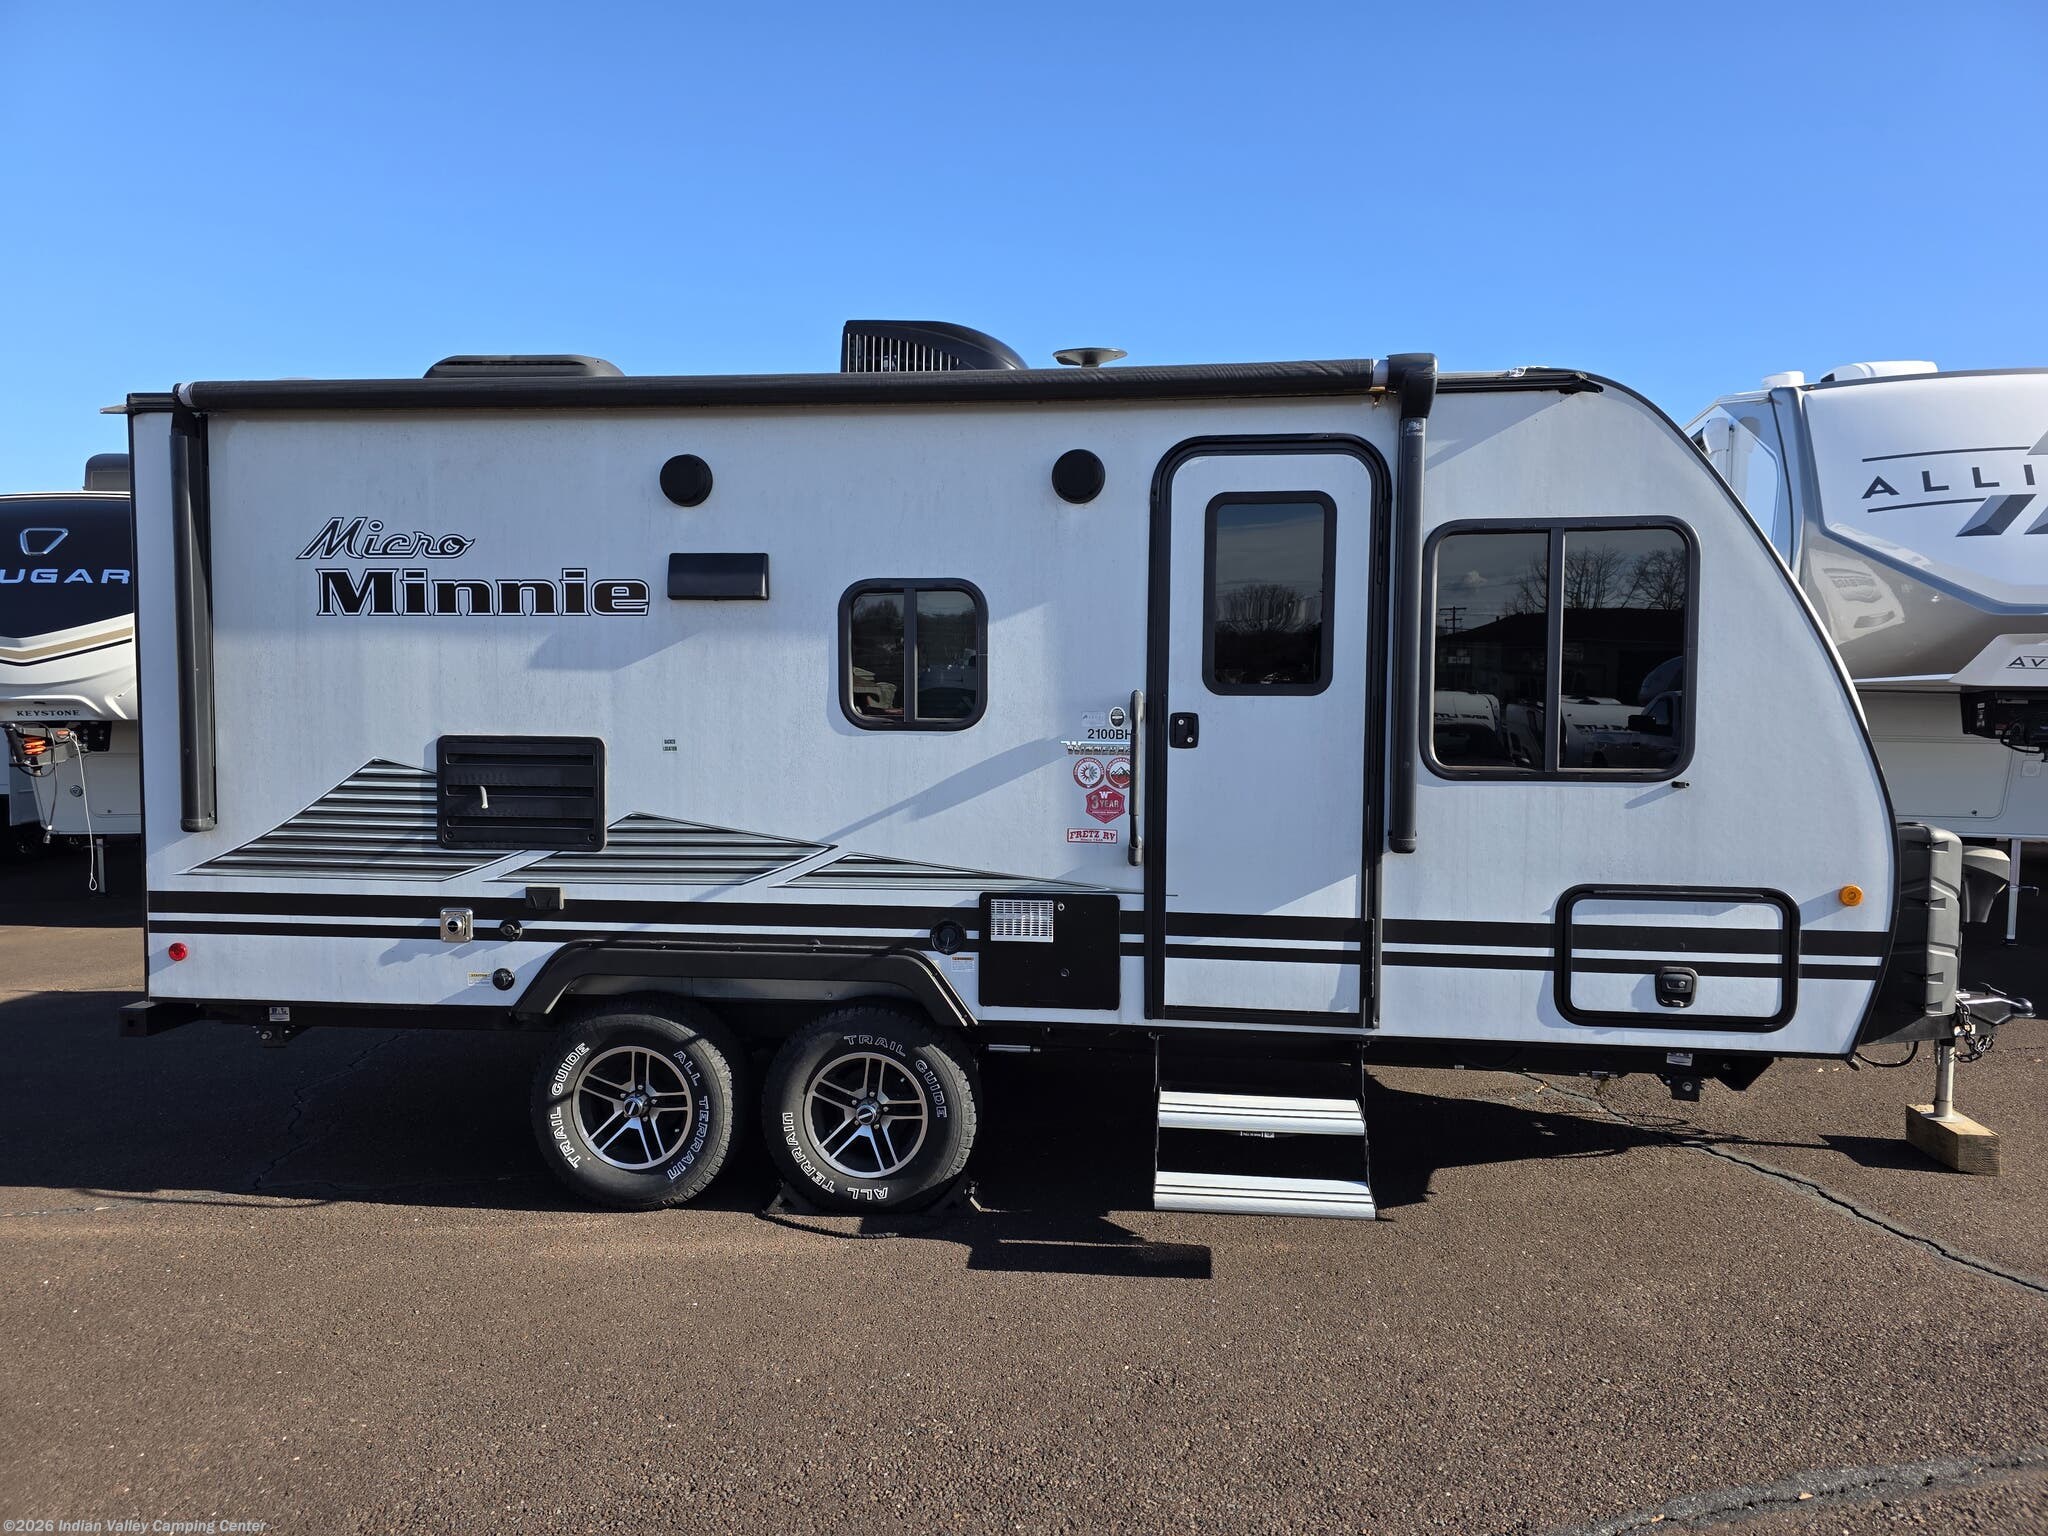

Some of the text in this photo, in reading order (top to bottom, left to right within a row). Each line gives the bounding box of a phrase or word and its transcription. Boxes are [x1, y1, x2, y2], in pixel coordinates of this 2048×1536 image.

[1861, 464, 2036, 500] ALLI
[296, 516, 476, 560] Micro
[0, 568, 131, 584] UGAR
[315, 567, 650, 617] Minnie
[2007, 656, 2047, 668] AV
[16, 709, 80, 717] KEYSTONE
[1087, 728, 1133, 740] 2100BH
[1091, 794, 1120, 810] 3 YEAR
[1069, 830, 1100, 839] FRETZ
[1102, 831, 1116, 841] RV
[843, 1034, 948, 1118] TRAIL GUIDE
[550, 1042, 590, 1169] TRAIL GUIDE
[667, 1050, 709, 1180] ALL TERRAIN
[782, 1112, 888, 1200] ALL TERRAIN
